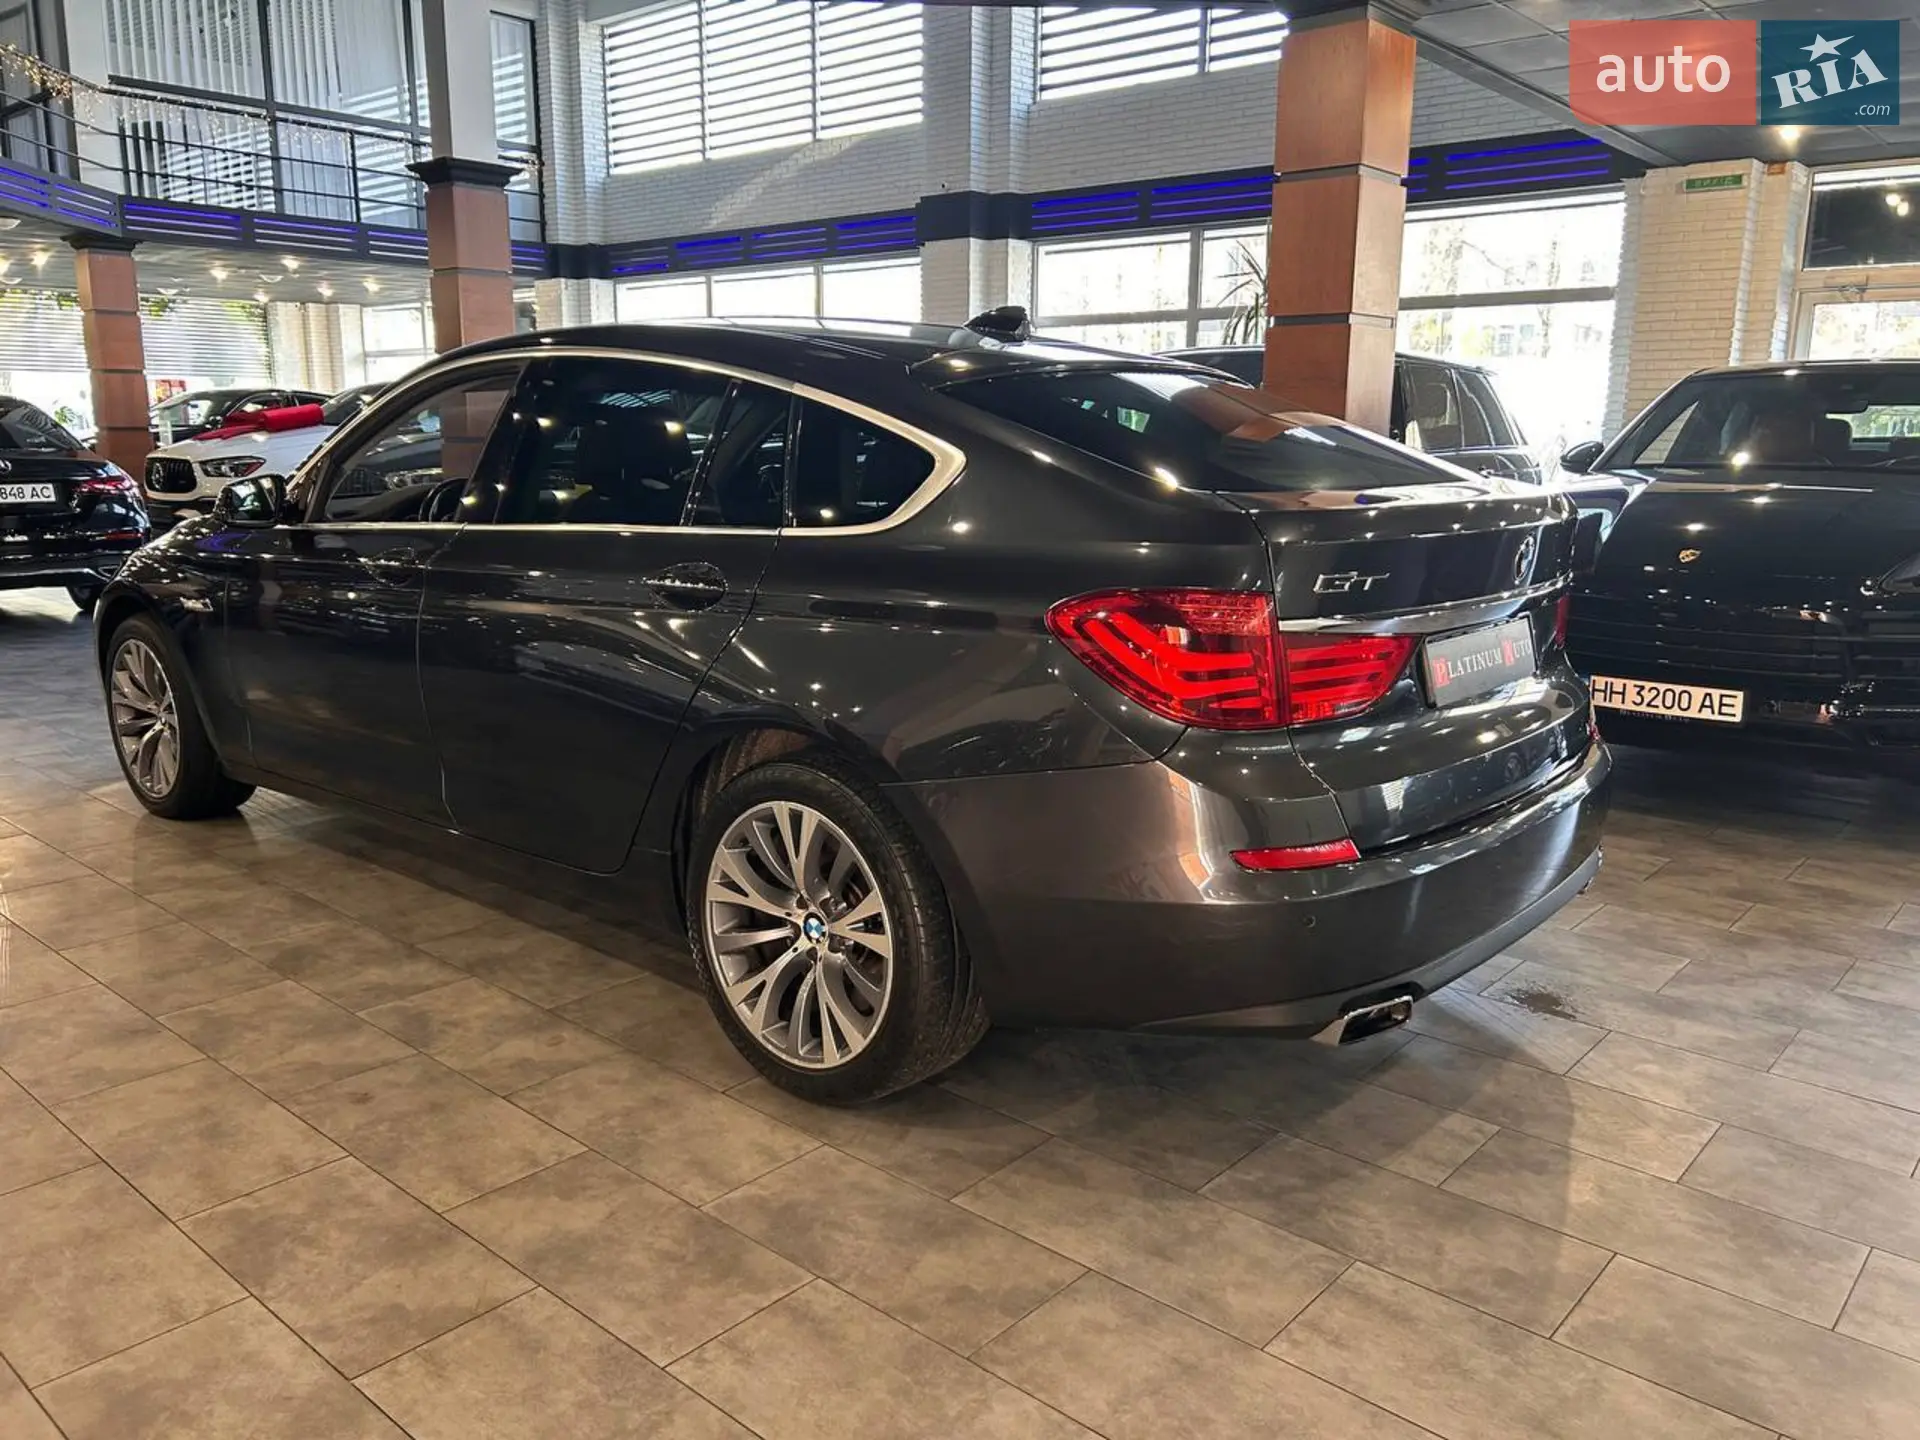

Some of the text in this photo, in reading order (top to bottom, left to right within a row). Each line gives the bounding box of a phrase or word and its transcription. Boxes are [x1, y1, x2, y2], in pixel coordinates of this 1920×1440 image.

[30, 486, 52, 499] AC
[1313, 571, 1391, 594] GT
[1591, 679, 1627, 705] HH
[1631, 684, 1693, 712] 3200
[1698, 692, 1738, 717] AE
